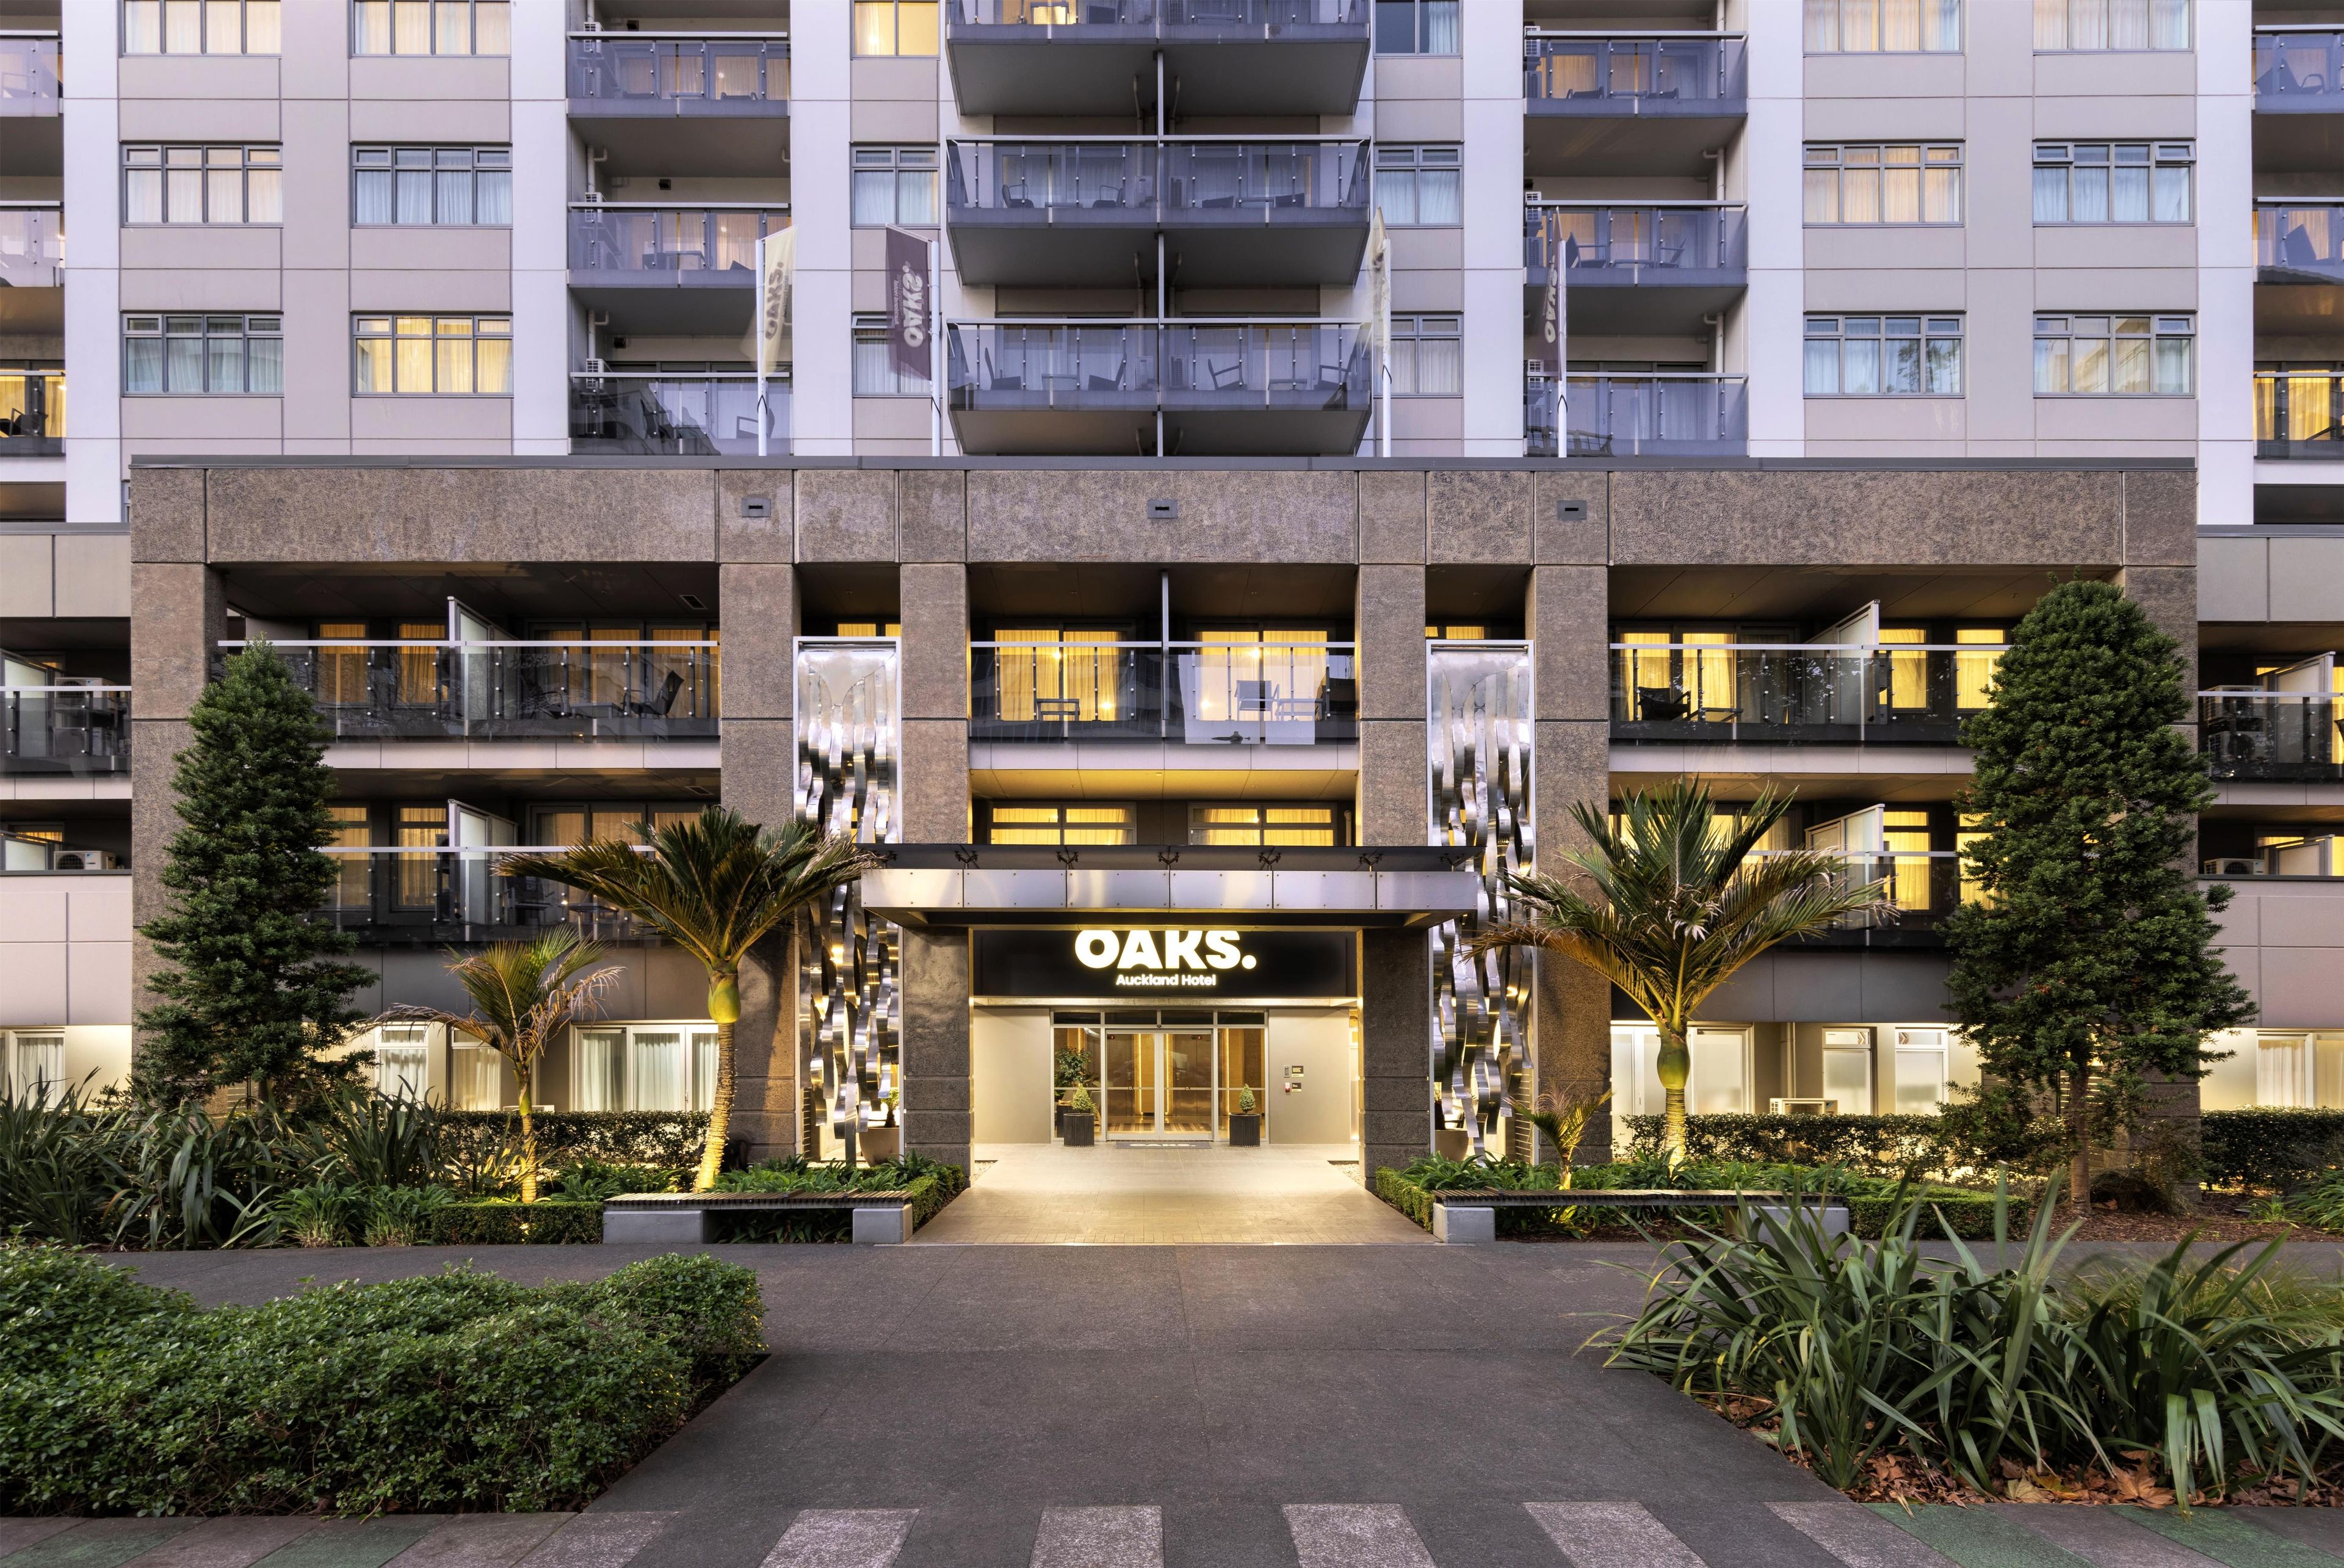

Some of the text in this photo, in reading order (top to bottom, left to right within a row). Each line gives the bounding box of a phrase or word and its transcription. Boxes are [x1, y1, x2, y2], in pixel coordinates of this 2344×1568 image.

[765, 262, 784, 340] OAKS.
[1075, 930, 1256, 969] OAKS.
[1116, 974, 1216, 985] Auckland Hotel
